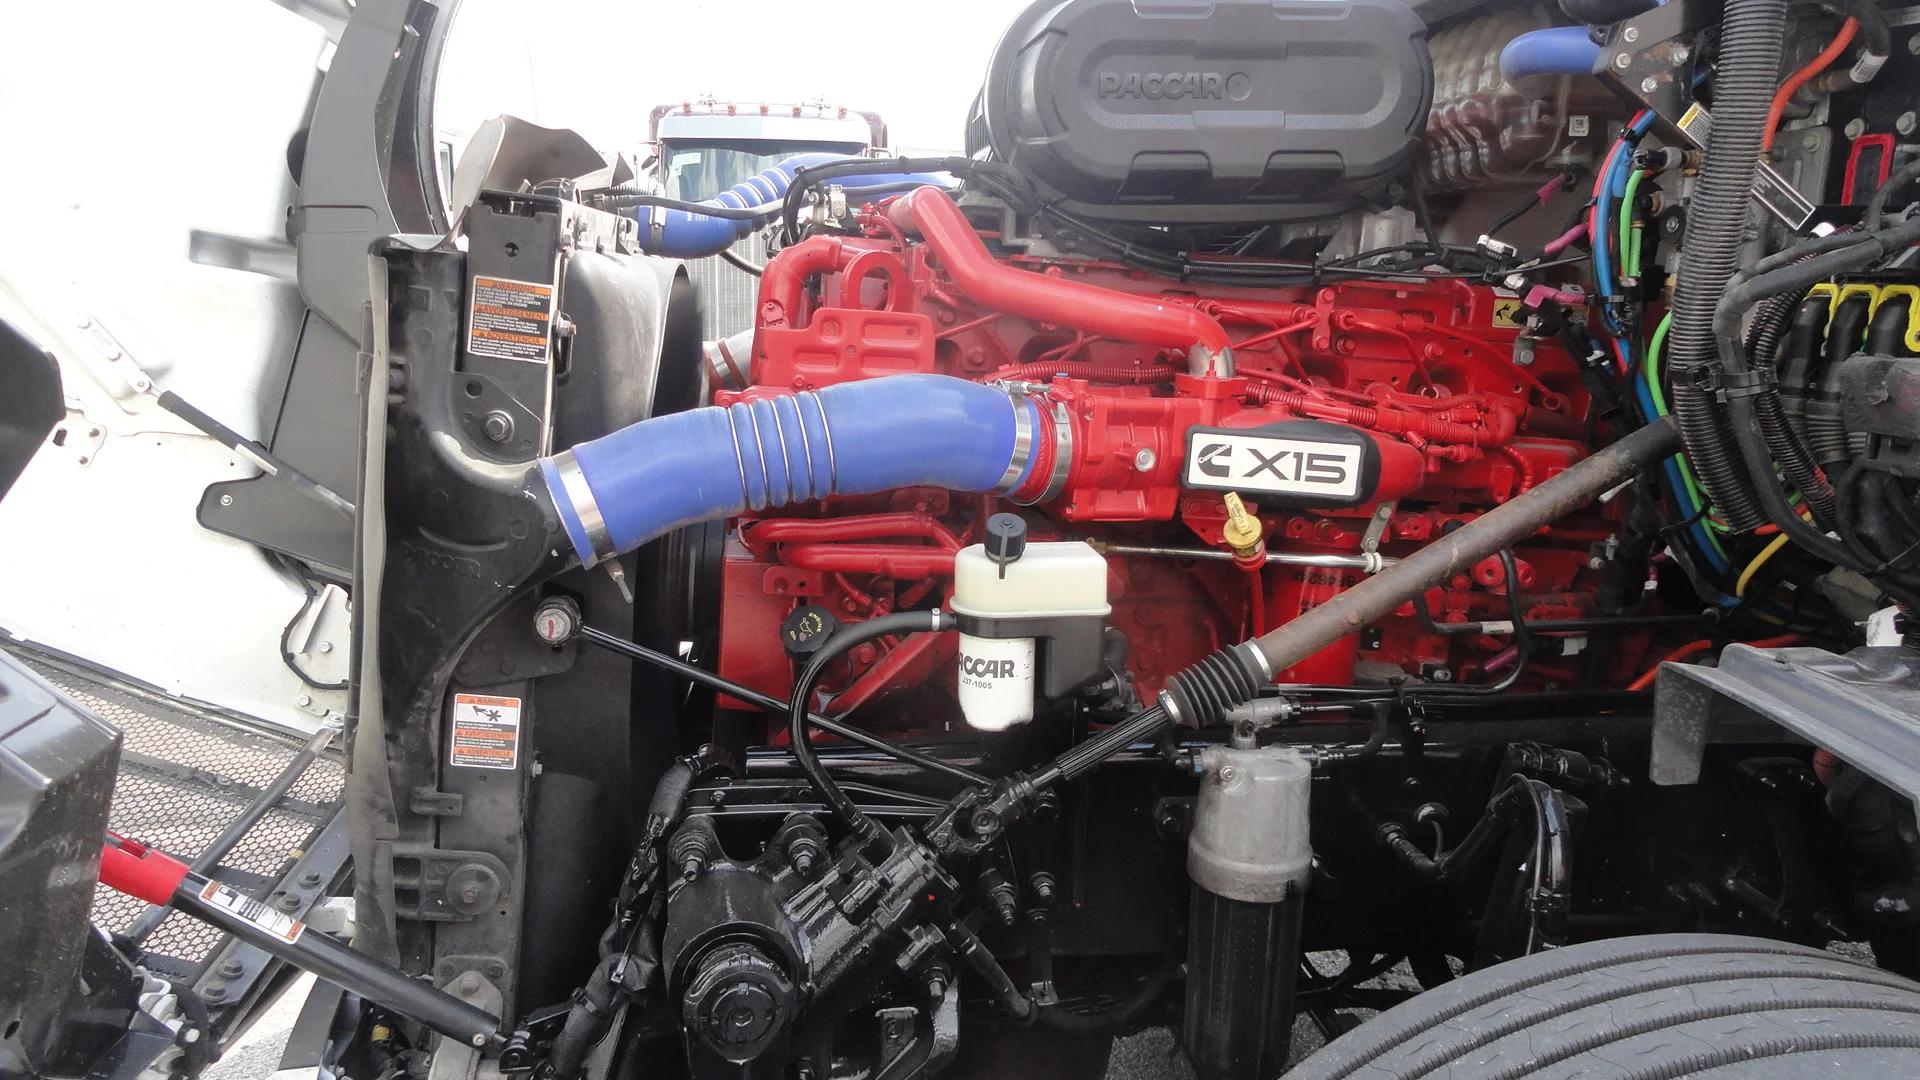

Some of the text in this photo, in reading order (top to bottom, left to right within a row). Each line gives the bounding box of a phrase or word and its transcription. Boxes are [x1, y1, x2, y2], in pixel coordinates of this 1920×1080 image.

[1099, 72, 1222, 100] PACCAR
[499, 282, 535, 292] WARNING
[486, 330, 539, 344] ADVERTENCIA
[1198, 443, 1346, 484] Cummins X15
[958, 652, 1015, 678] ACCAR
